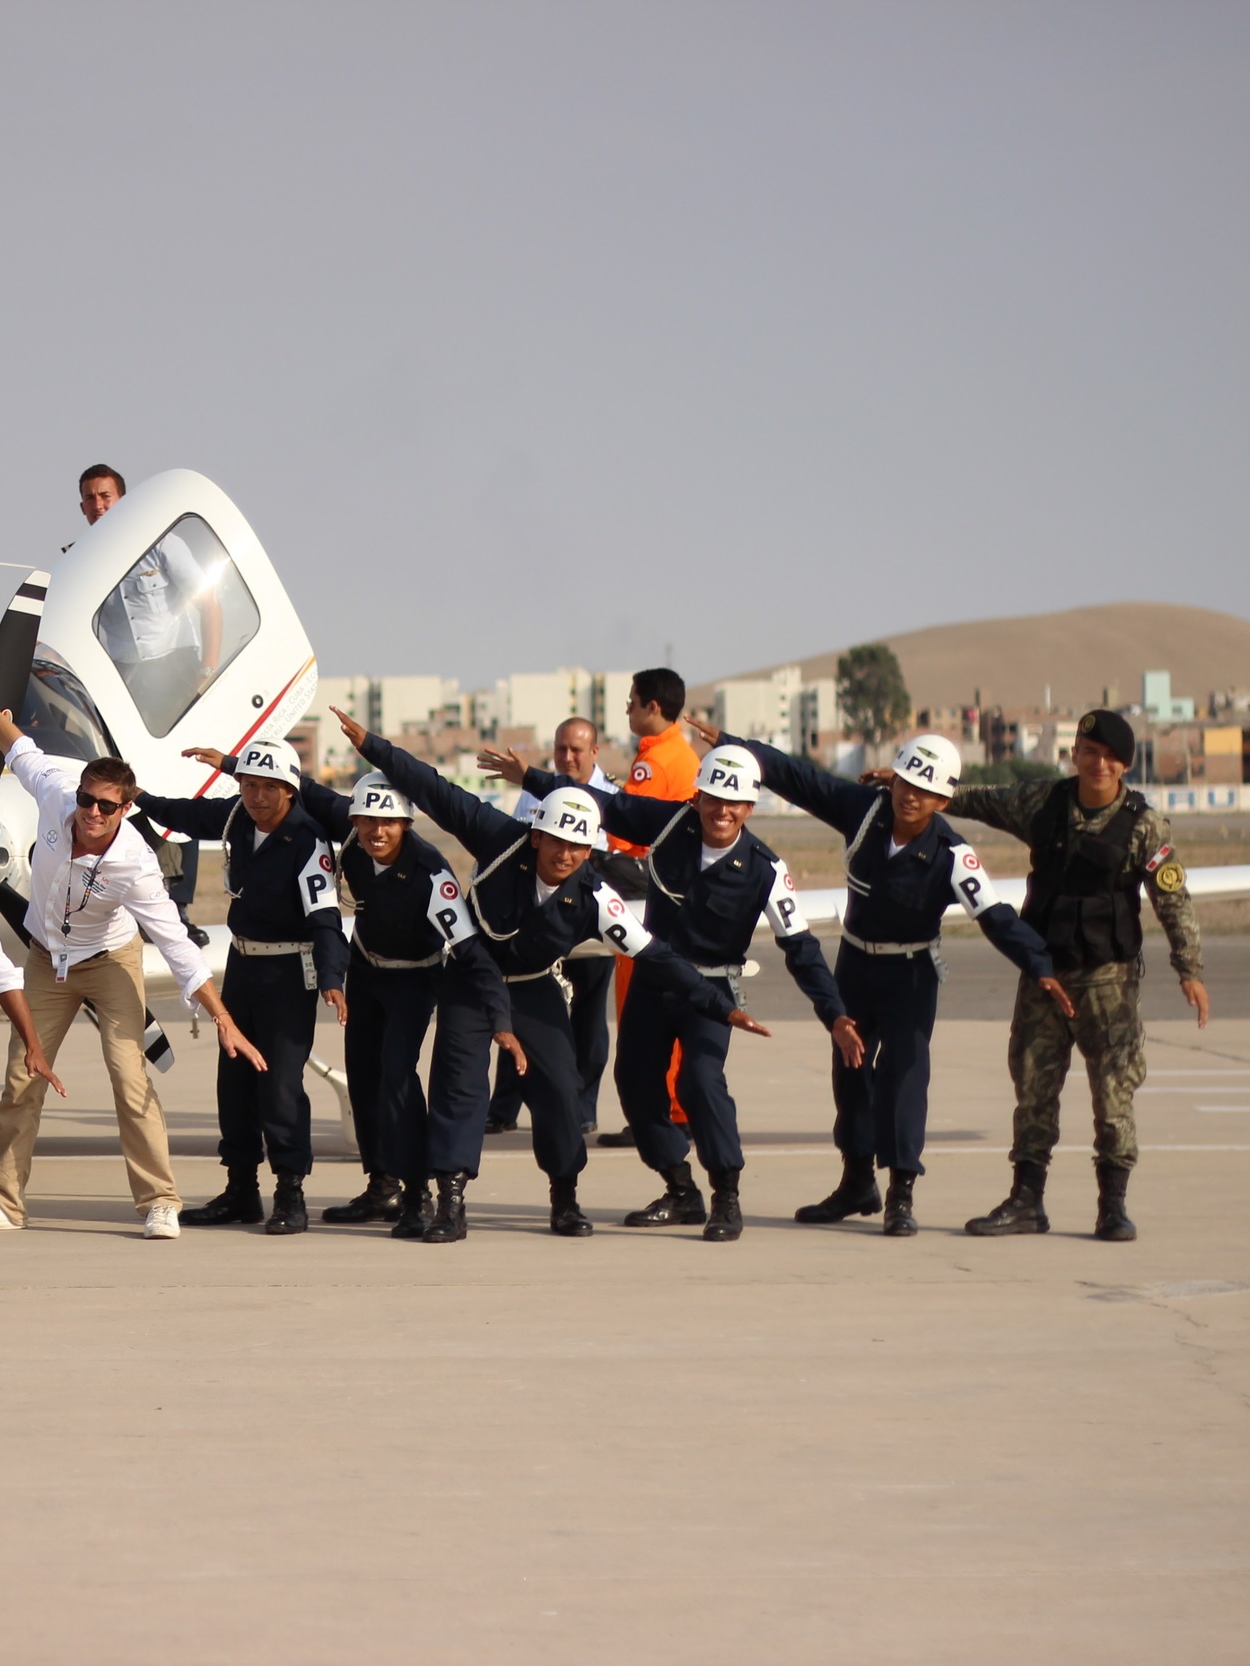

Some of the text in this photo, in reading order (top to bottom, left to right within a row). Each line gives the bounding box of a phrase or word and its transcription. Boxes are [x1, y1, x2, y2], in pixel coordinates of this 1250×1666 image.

[246, 751, 274, 771] PA
[905, 756, 935, 783] PA
[709, 768, 739, 791] PA
[365, 792, 395, 811] PA
[558, 813, 588, 837] PA
[306, 873, 327, 905] P
[959, 877, 981, 909] P
[435, 907, 458, 940] P
[776, 897, 796, 928] P
[604, 923, 629, 953] P
